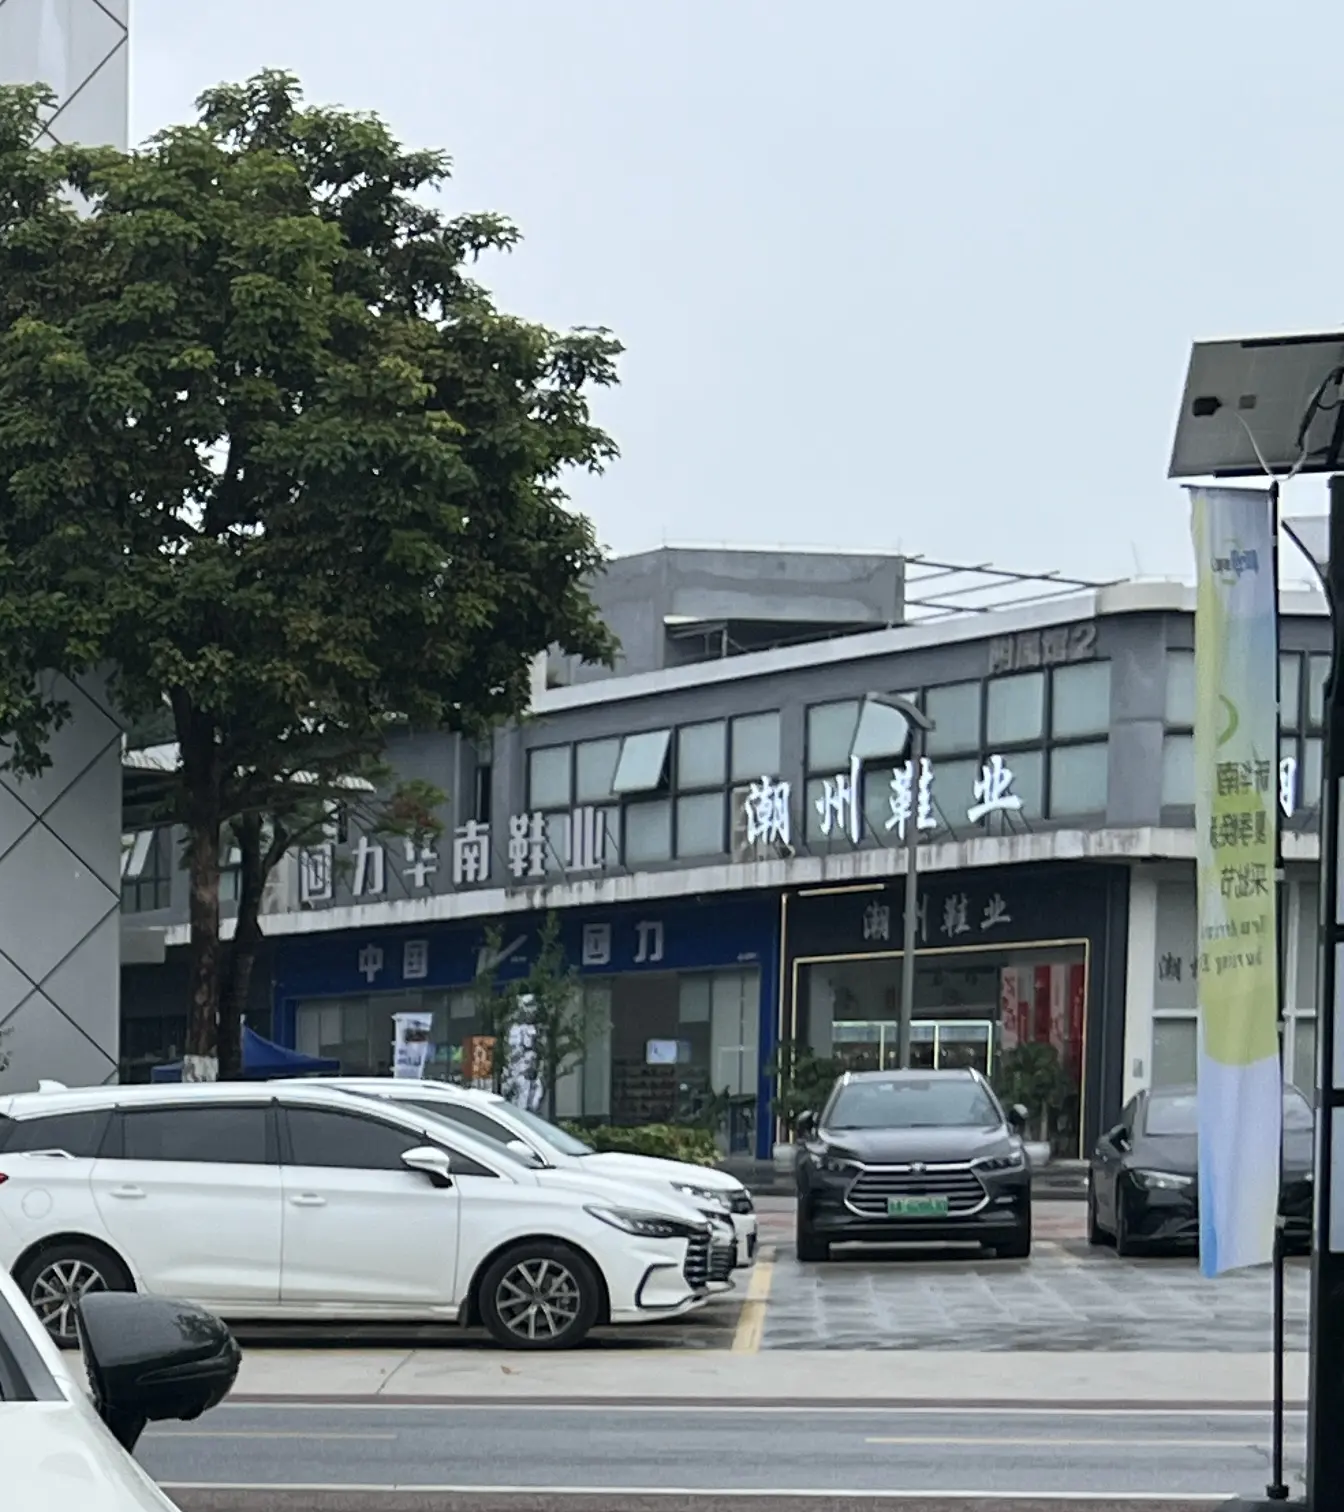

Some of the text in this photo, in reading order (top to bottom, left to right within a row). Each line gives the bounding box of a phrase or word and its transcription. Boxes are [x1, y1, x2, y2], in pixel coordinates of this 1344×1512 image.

[744, 754, 1023, 846] 潮州鞋业
[298, 805, 605, 901] 回力华南鞋业
[358, 920, 664, 983] 中国 回力
